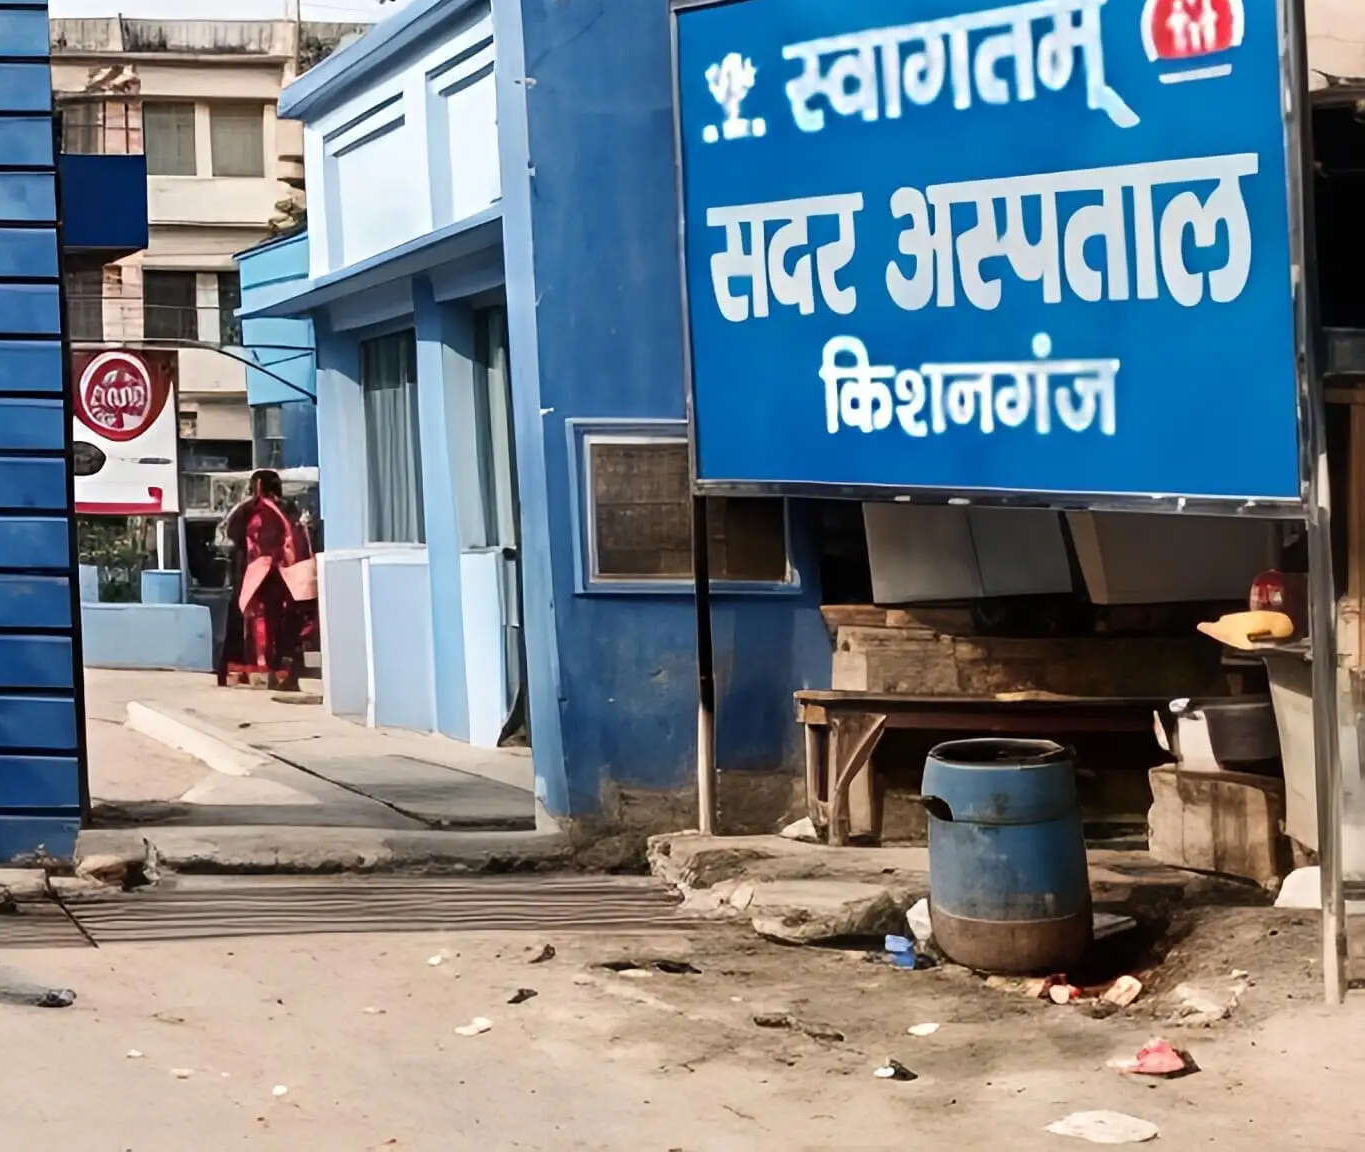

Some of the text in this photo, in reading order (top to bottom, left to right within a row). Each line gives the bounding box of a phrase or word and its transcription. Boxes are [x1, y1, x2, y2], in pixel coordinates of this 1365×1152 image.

[706, 152, 1259, 323] सदर अस्पताल
[818, 332, 1121, 438] किशनगंज
